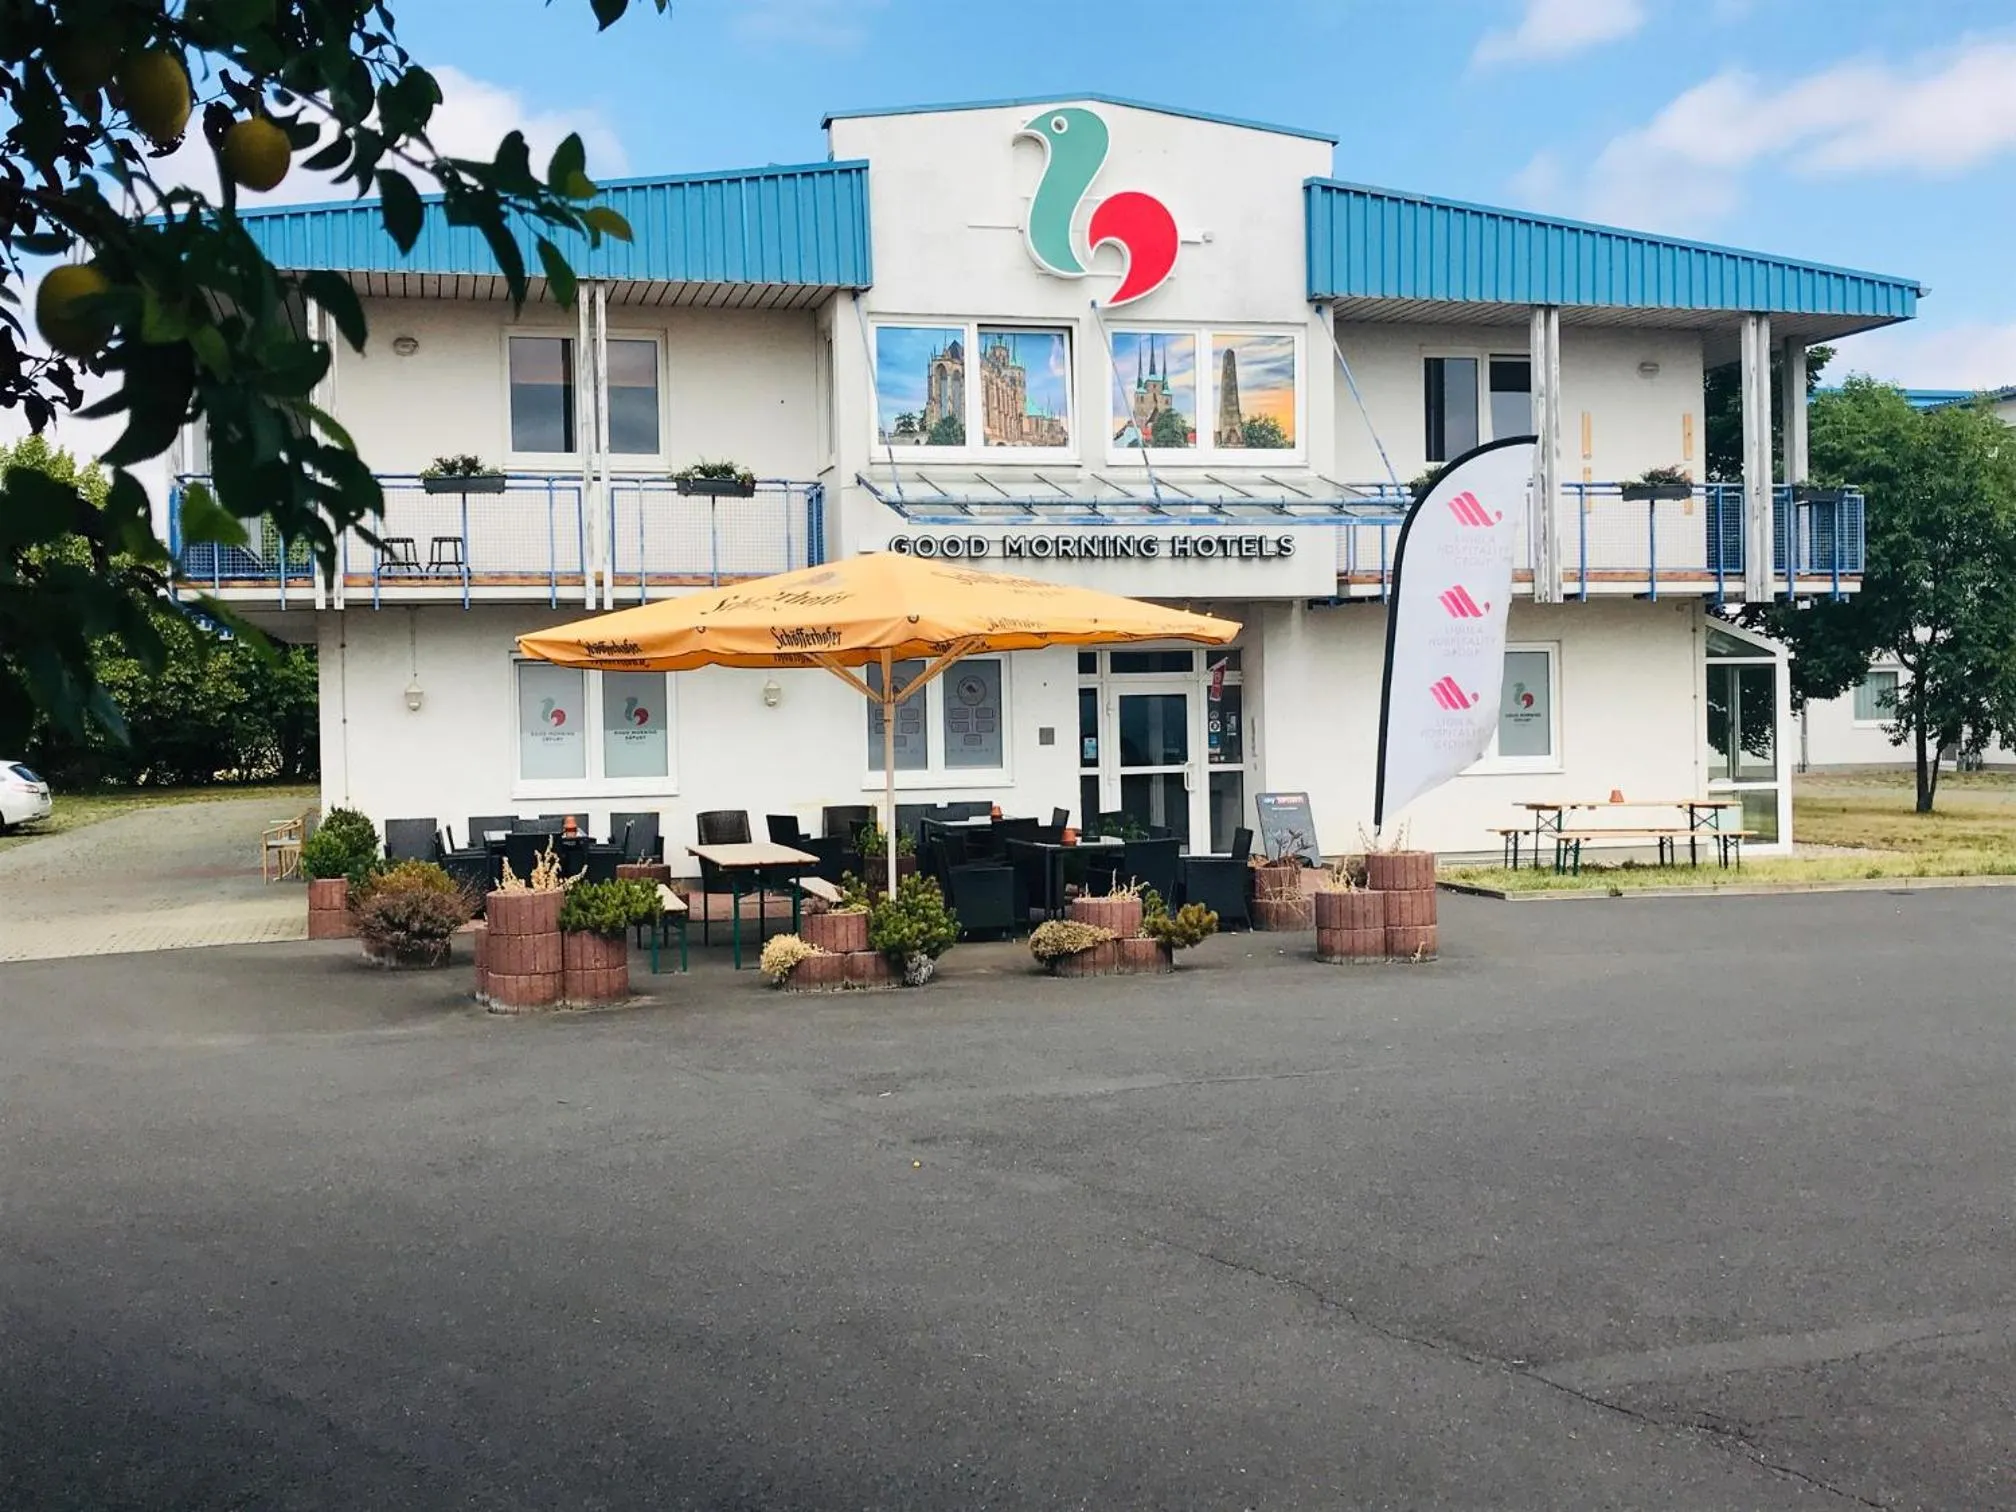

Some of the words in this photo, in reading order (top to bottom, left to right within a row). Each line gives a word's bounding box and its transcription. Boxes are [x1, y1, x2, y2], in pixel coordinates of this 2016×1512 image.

[889, 534, 990, 559] GOOD
[1003, 534, 1160, 559] MORNING
[1172, 534, 1296, 559] HOTELS
[770, 626, 842, 650] Schöfferhofer
